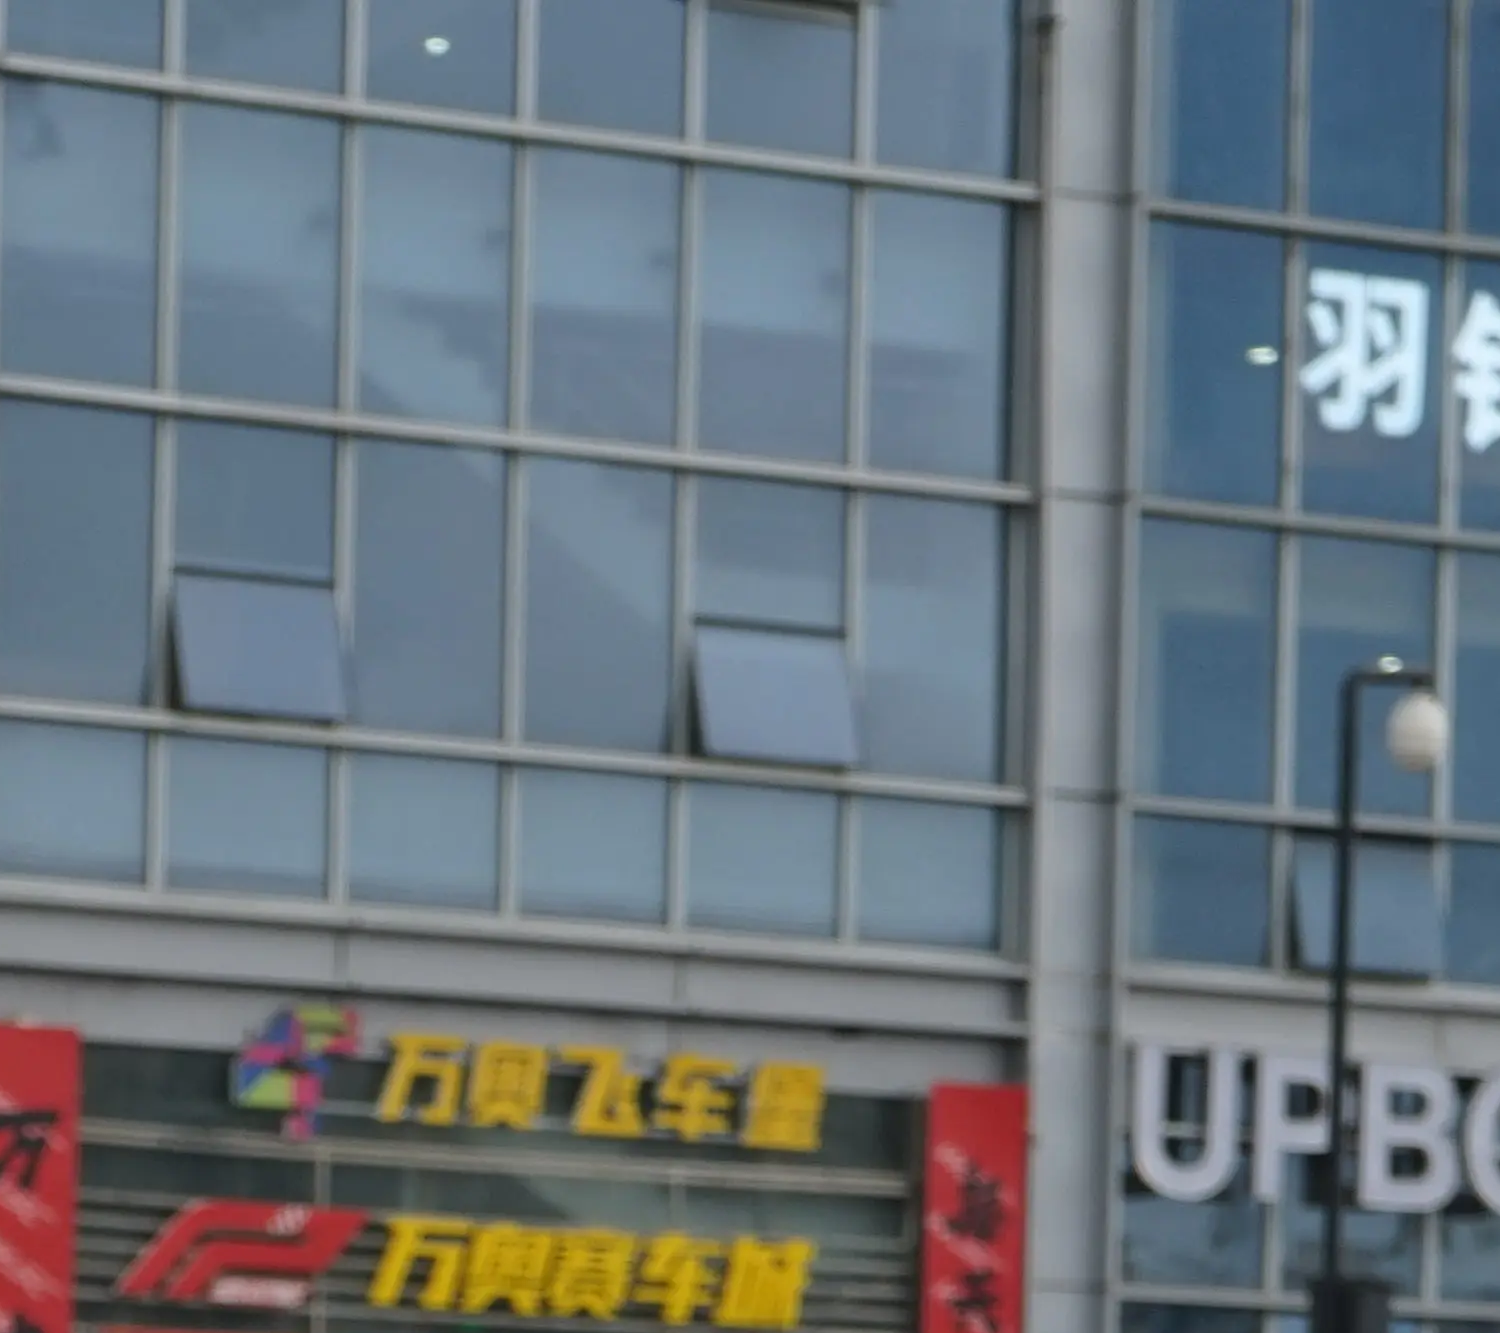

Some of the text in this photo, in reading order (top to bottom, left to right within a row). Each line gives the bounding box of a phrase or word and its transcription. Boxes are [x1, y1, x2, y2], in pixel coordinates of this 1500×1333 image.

[376, 1031, 826, 1153] 万奥飞车堡
[367, 1213, 819, 1331] 万奥赛车城
